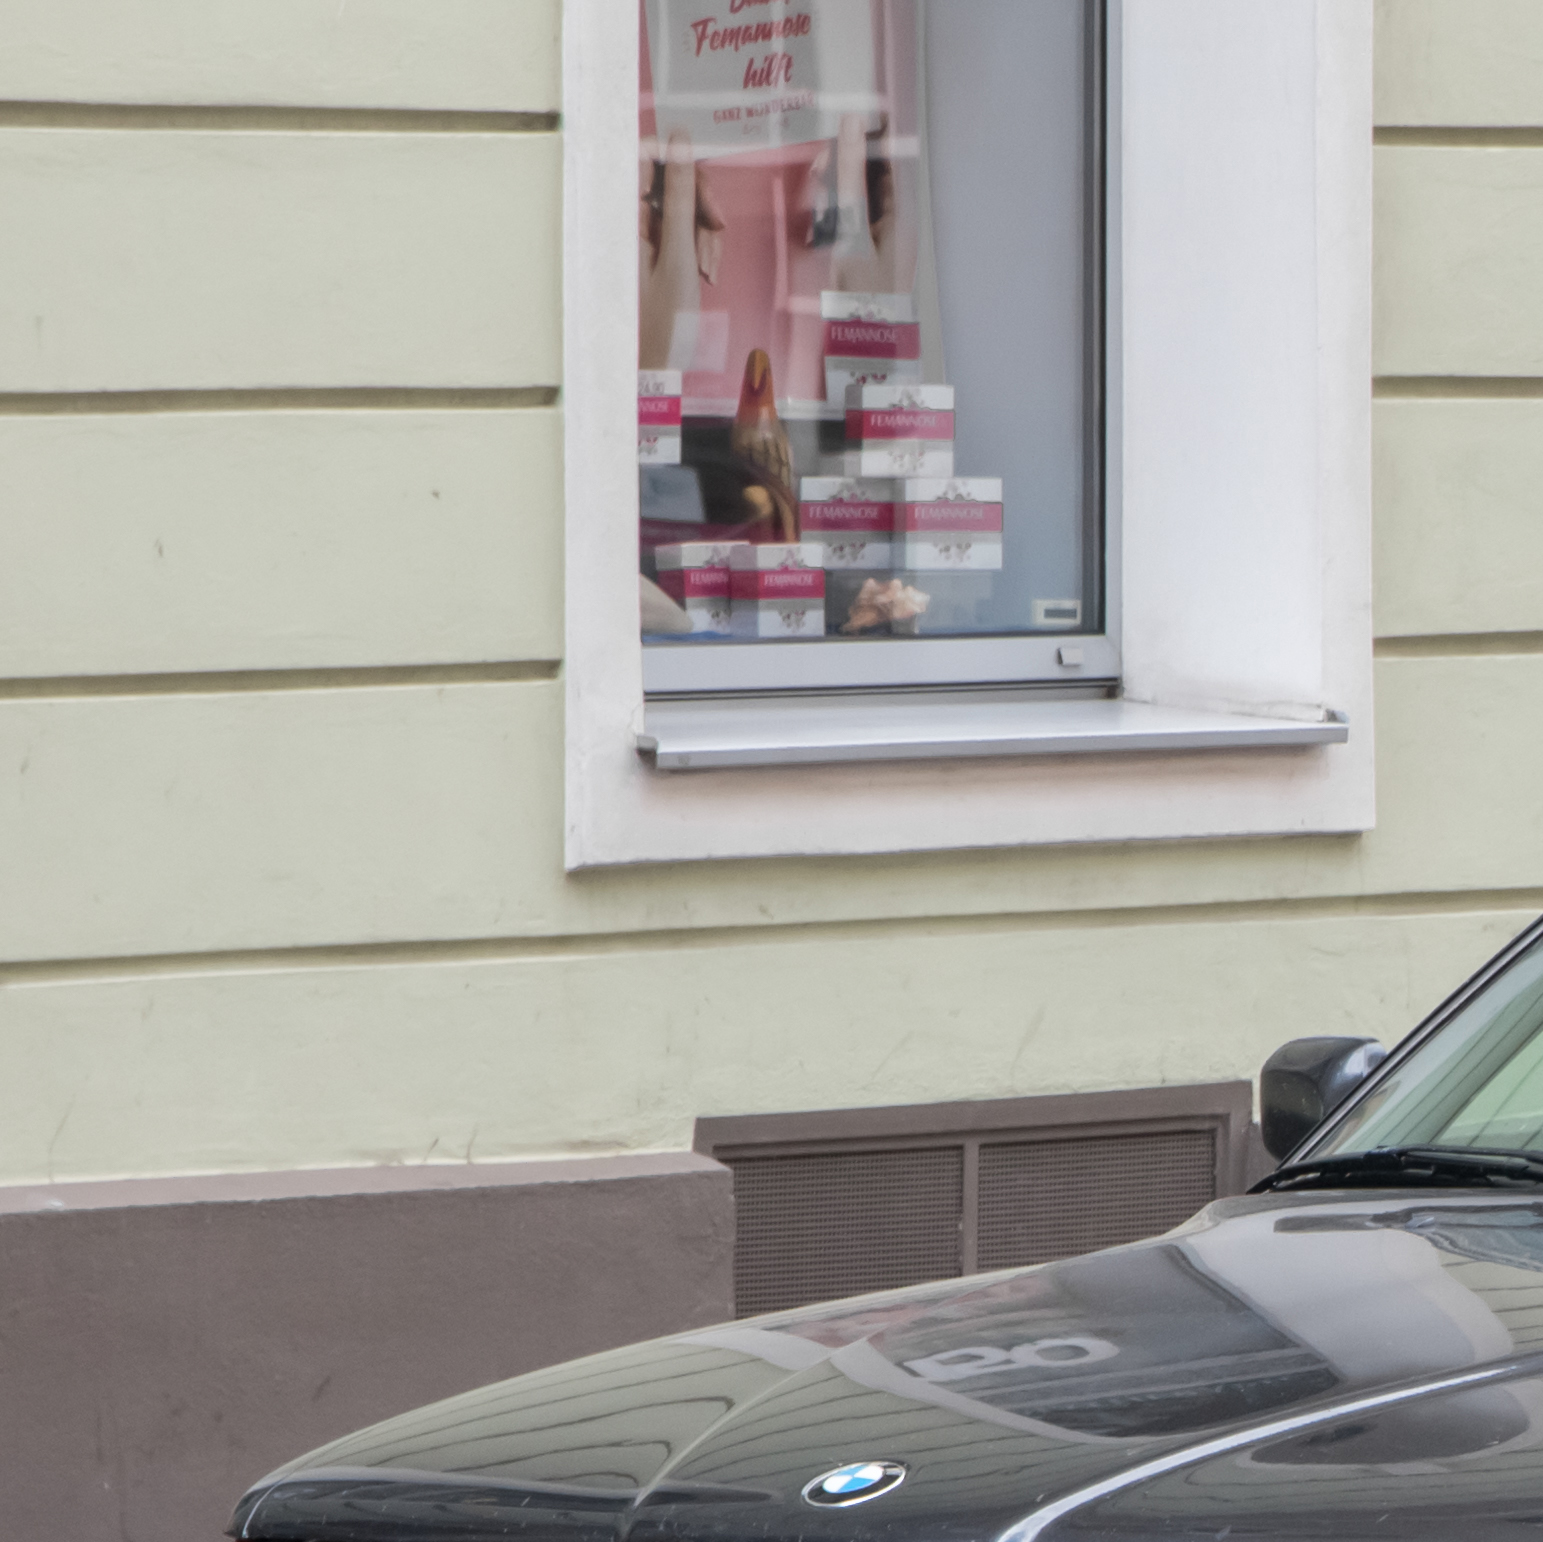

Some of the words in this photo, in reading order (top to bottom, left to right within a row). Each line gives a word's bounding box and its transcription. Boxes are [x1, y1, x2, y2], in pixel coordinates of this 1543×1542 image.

[690, 13, 812, 57] Femannose
[743, 52, 794, 89] hilft
[831, 326, 899, 344] FEMANNOSE
[870, 414, 939, 428] FEMANNOSE
[809, 506, 880, 521] FEMANNOSE
[914, 506, 985, 521] FEMANNOSE
[764, 572, 814, 587] FEMANNOSE
